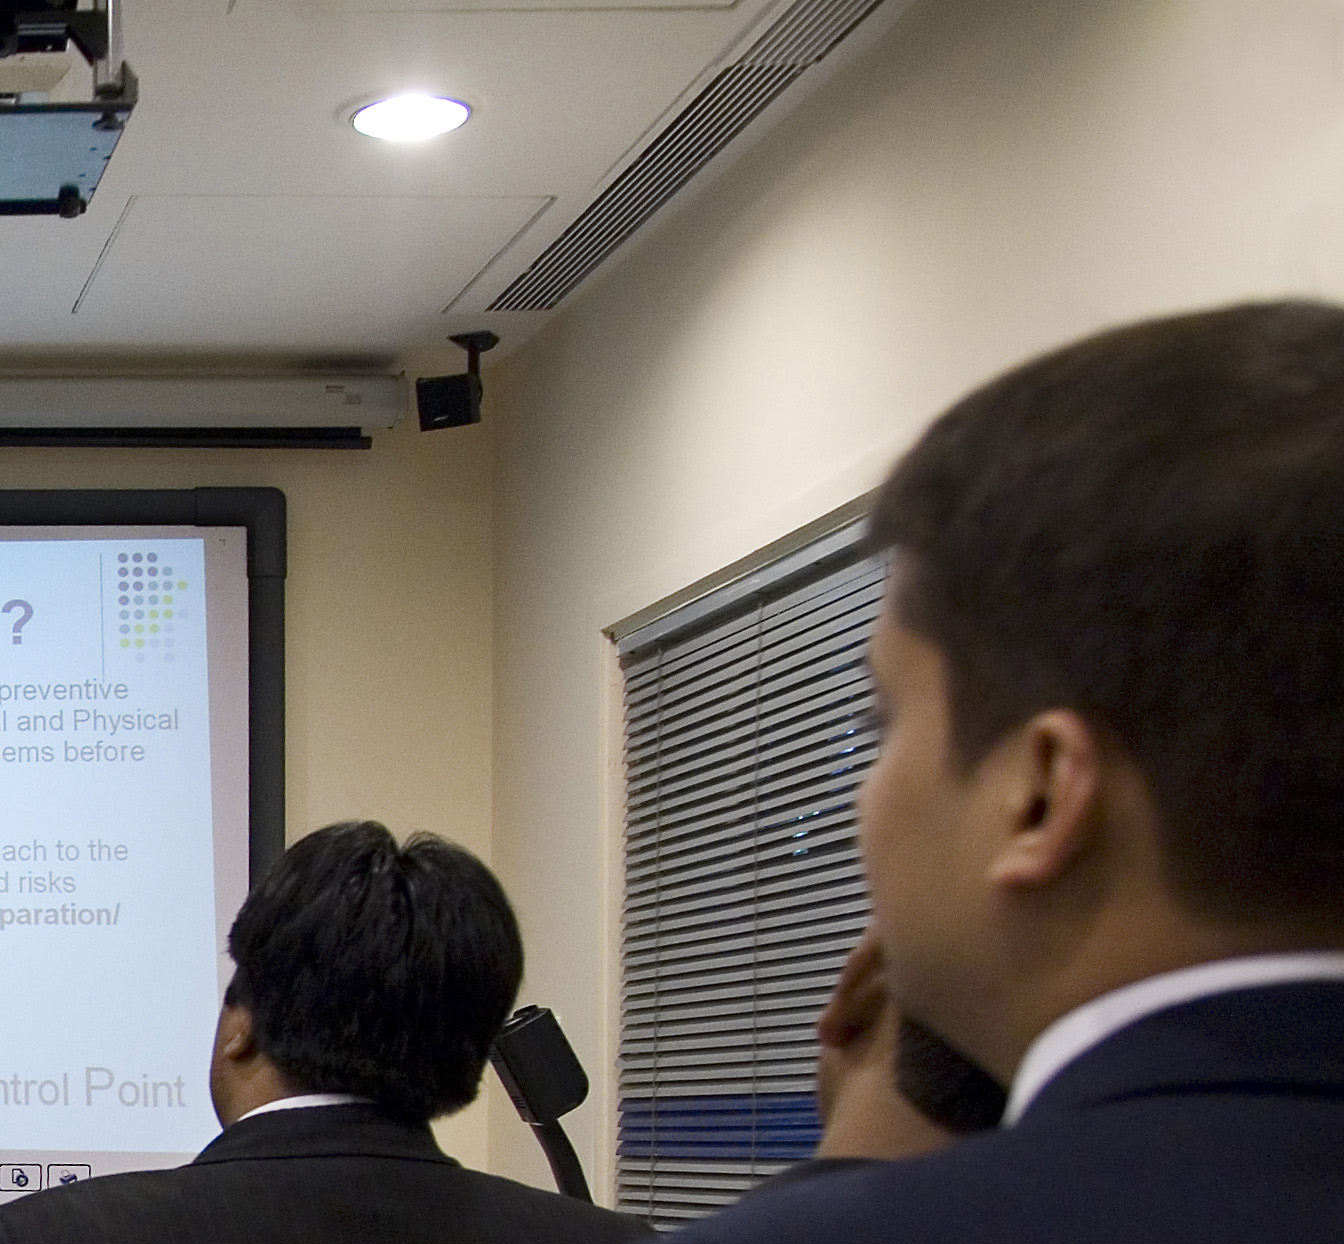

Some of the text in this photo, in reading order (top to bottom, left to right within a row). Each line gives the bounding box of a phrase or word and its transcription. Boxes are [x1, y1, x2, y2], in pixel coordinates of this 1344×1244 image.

[17, 710, 64, 731] and
[74, 708, 178, 735] Physical
[64, 741, 145, 762] before
[56, 840, 79, 861] to
[88, 839, 128, 861] the
[19, 871, 76, 893] risks
[85, 1067, 185, 1107] Point
